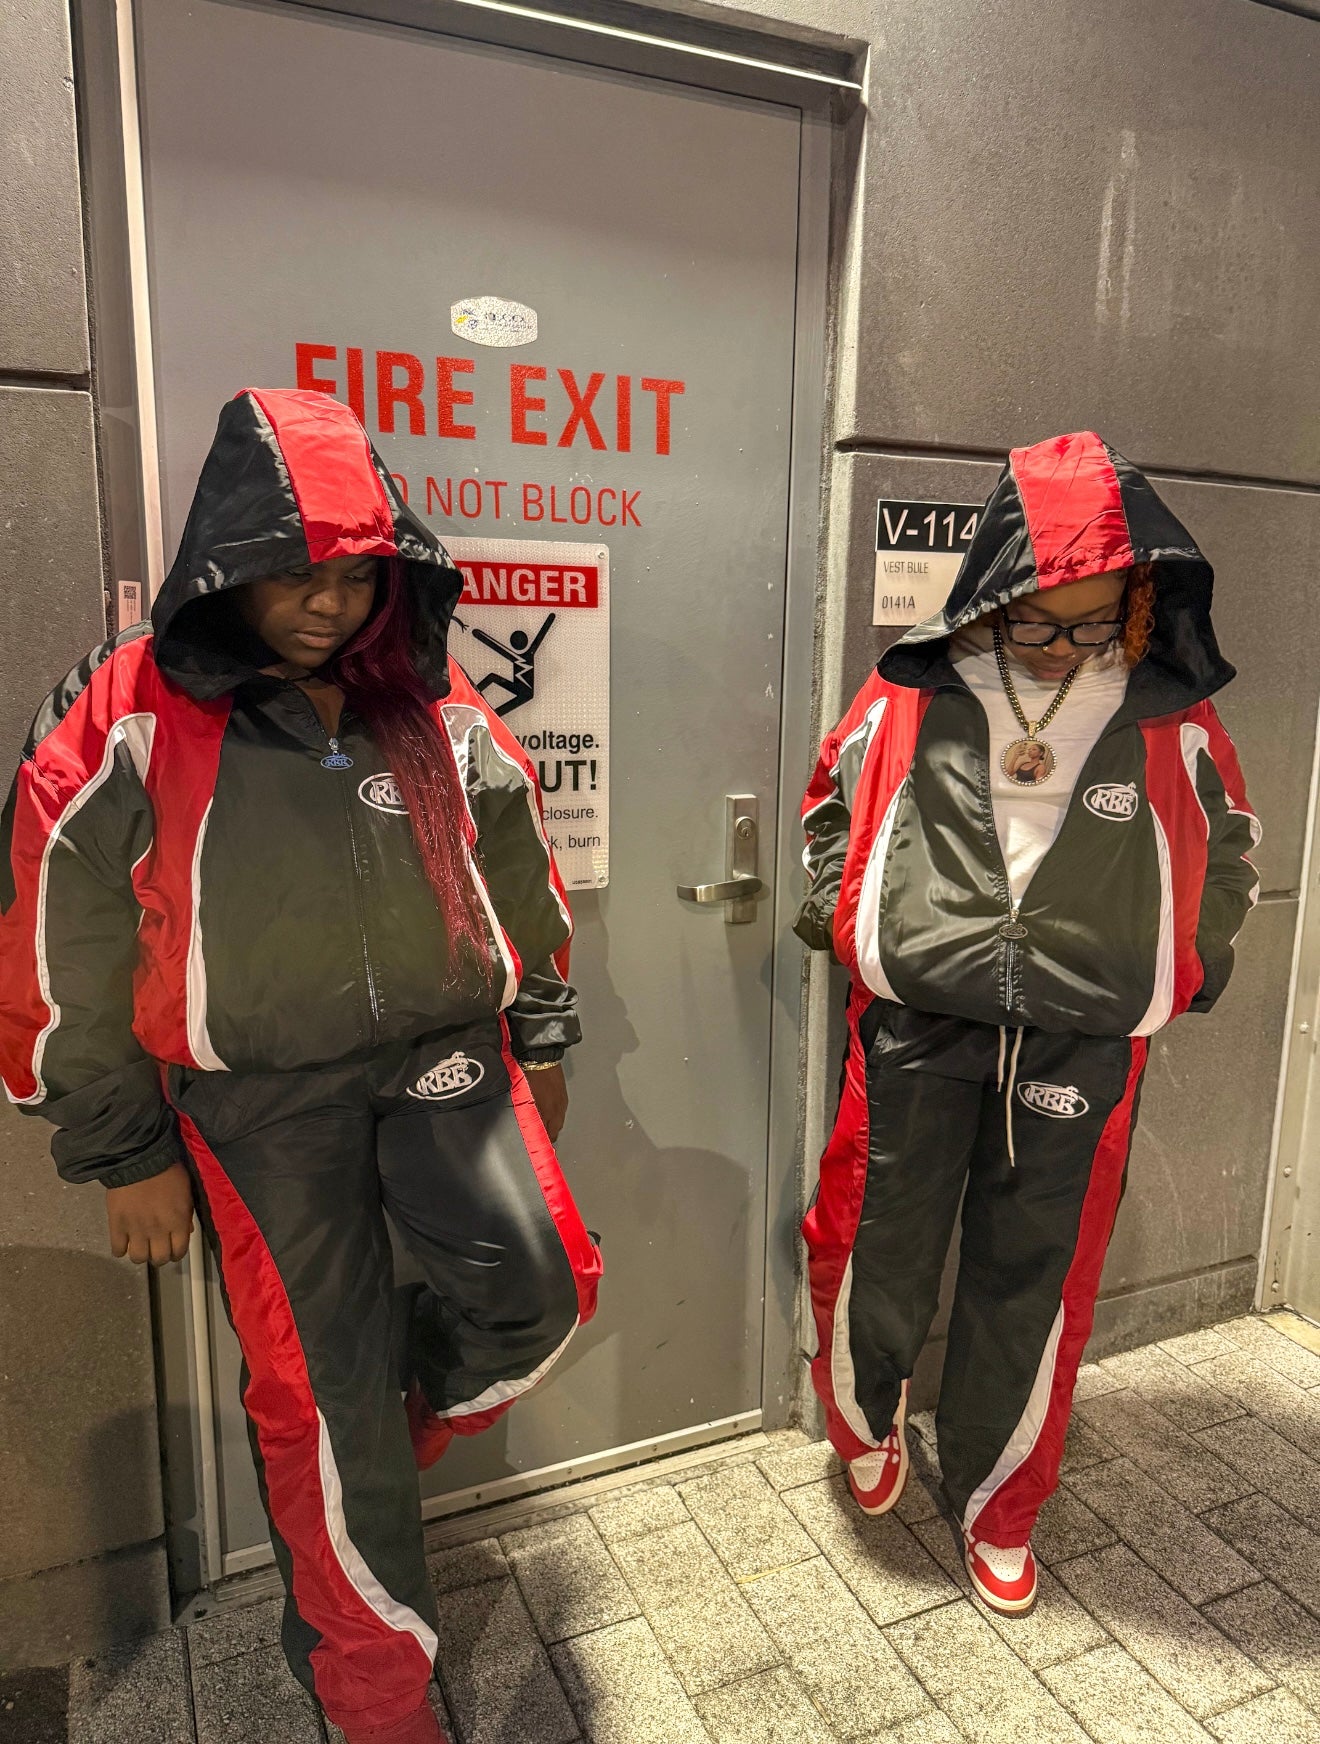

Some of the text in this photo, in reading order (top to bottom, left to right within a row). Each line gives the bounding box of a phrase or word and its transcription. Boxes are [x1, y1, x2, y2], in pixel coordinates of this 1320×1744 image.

[296, 343, 686, 456] FIRE EXIT
[426, 476, 508, 519] NOT
[523, 483, 642, 527] BLOCK
[883, 508, 978, 547] V-114
[459, 566, 588, 603] ANGER
[882, 595, 916, 609] 0141A
[515, 730, 600, 754] voltage.
[539, 760, 597, 793] UT!
[543, 806, 599, 821] closure.
[568, 834, 601, 849] burn
[416, 1065, 473, 1095] RBB
[1024, 1084, 1075, 1114] RBB
